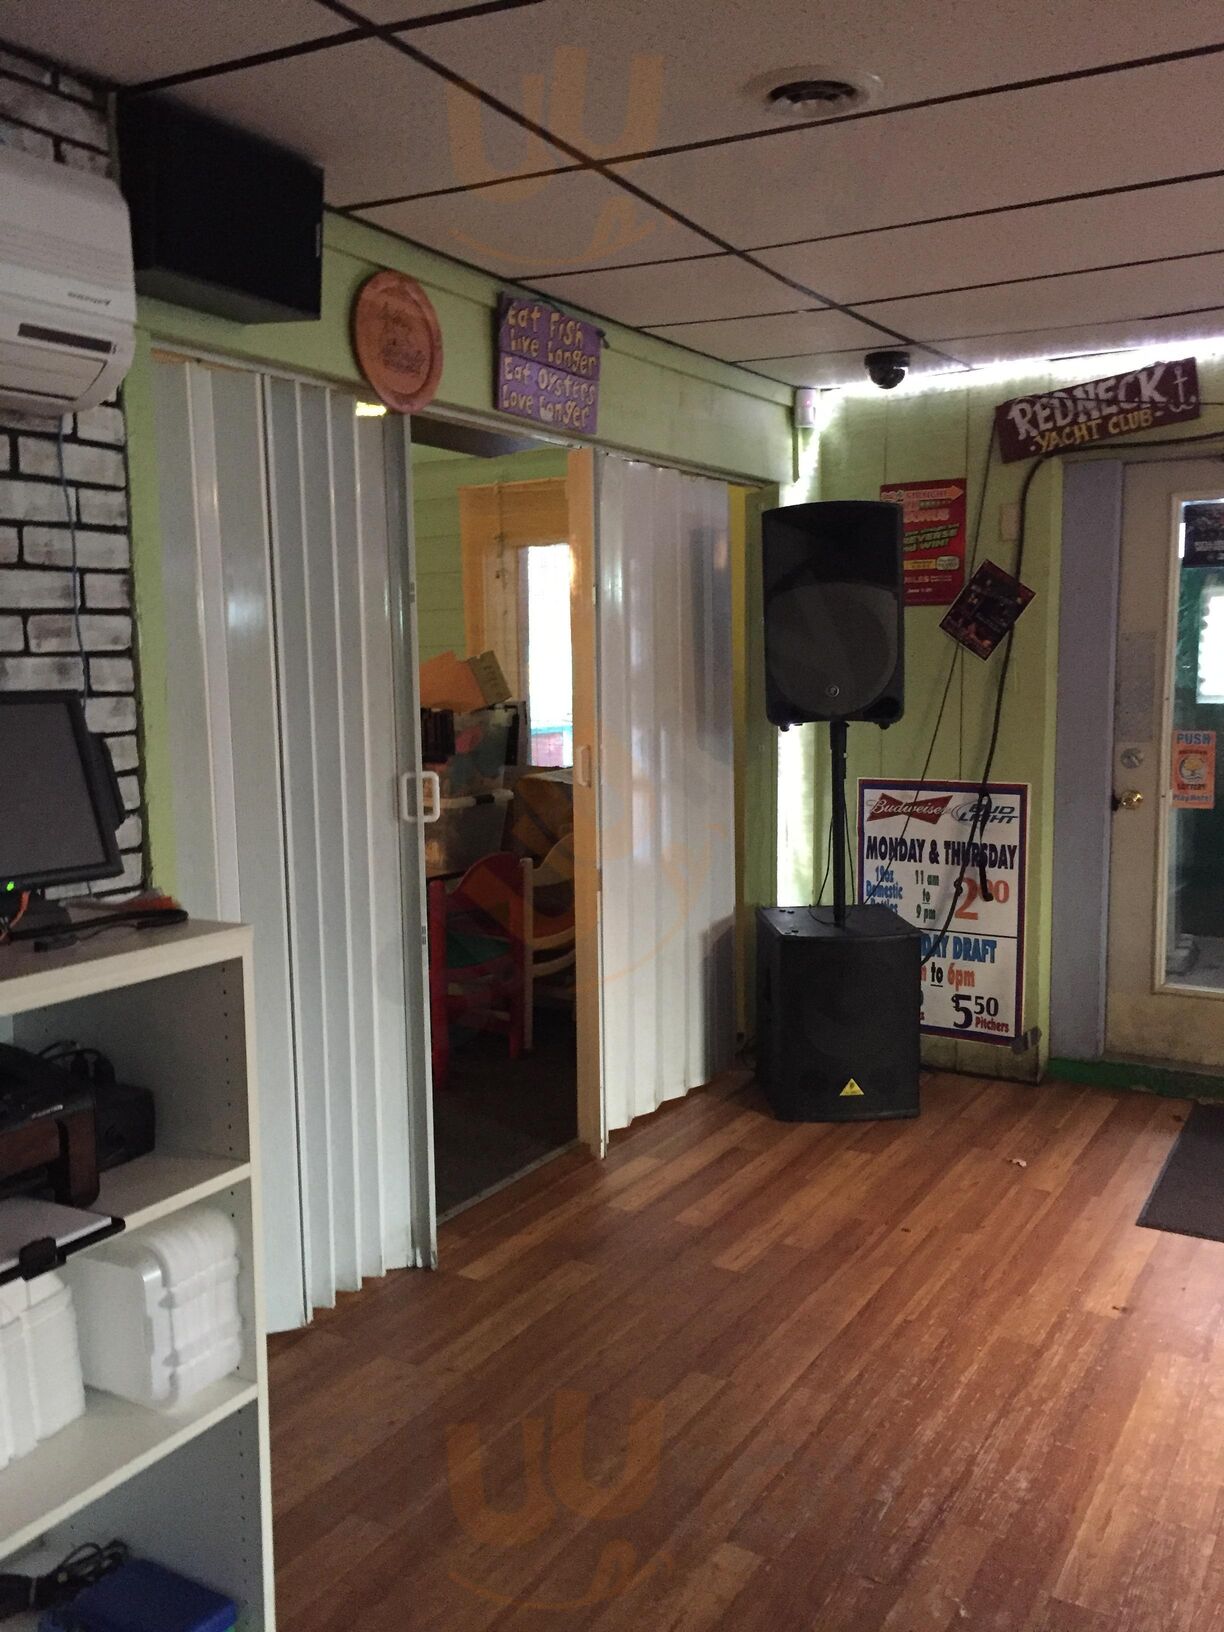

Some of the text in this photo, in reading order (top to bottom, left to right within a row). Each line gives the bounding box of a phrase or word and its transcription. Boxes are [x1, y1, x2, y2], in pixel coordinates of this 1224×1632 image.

[507, 303, 584, 347] Eat Fish
[511, 328, 596, 377] Live Longer
[504, 356, 531, 384] Eat
[502, 384, 590, 427] Love Longer
[1007, 362, 1167, 440] REDNECK
[1033, 408, 1154, 451] YACHT CLUB
[1177, 733, 1210, 745] PUSH
[867, 799, 946, 816] Budweiser
[866, 835, 1018, 870] MONDAY & THURSDAY
[866, 879, 903, 900] Domestic
[915, 869, 924, 885] 11
[922, 888, 931, 903] to
[916, 904, 936, 923] 9 pm
[953, 936, 997, 963] DRAFT
[930, 962, 944, 984] to
[947, 963, 975, 992] 6pm
[975, 1016, 1009, 1033] Pitchers
